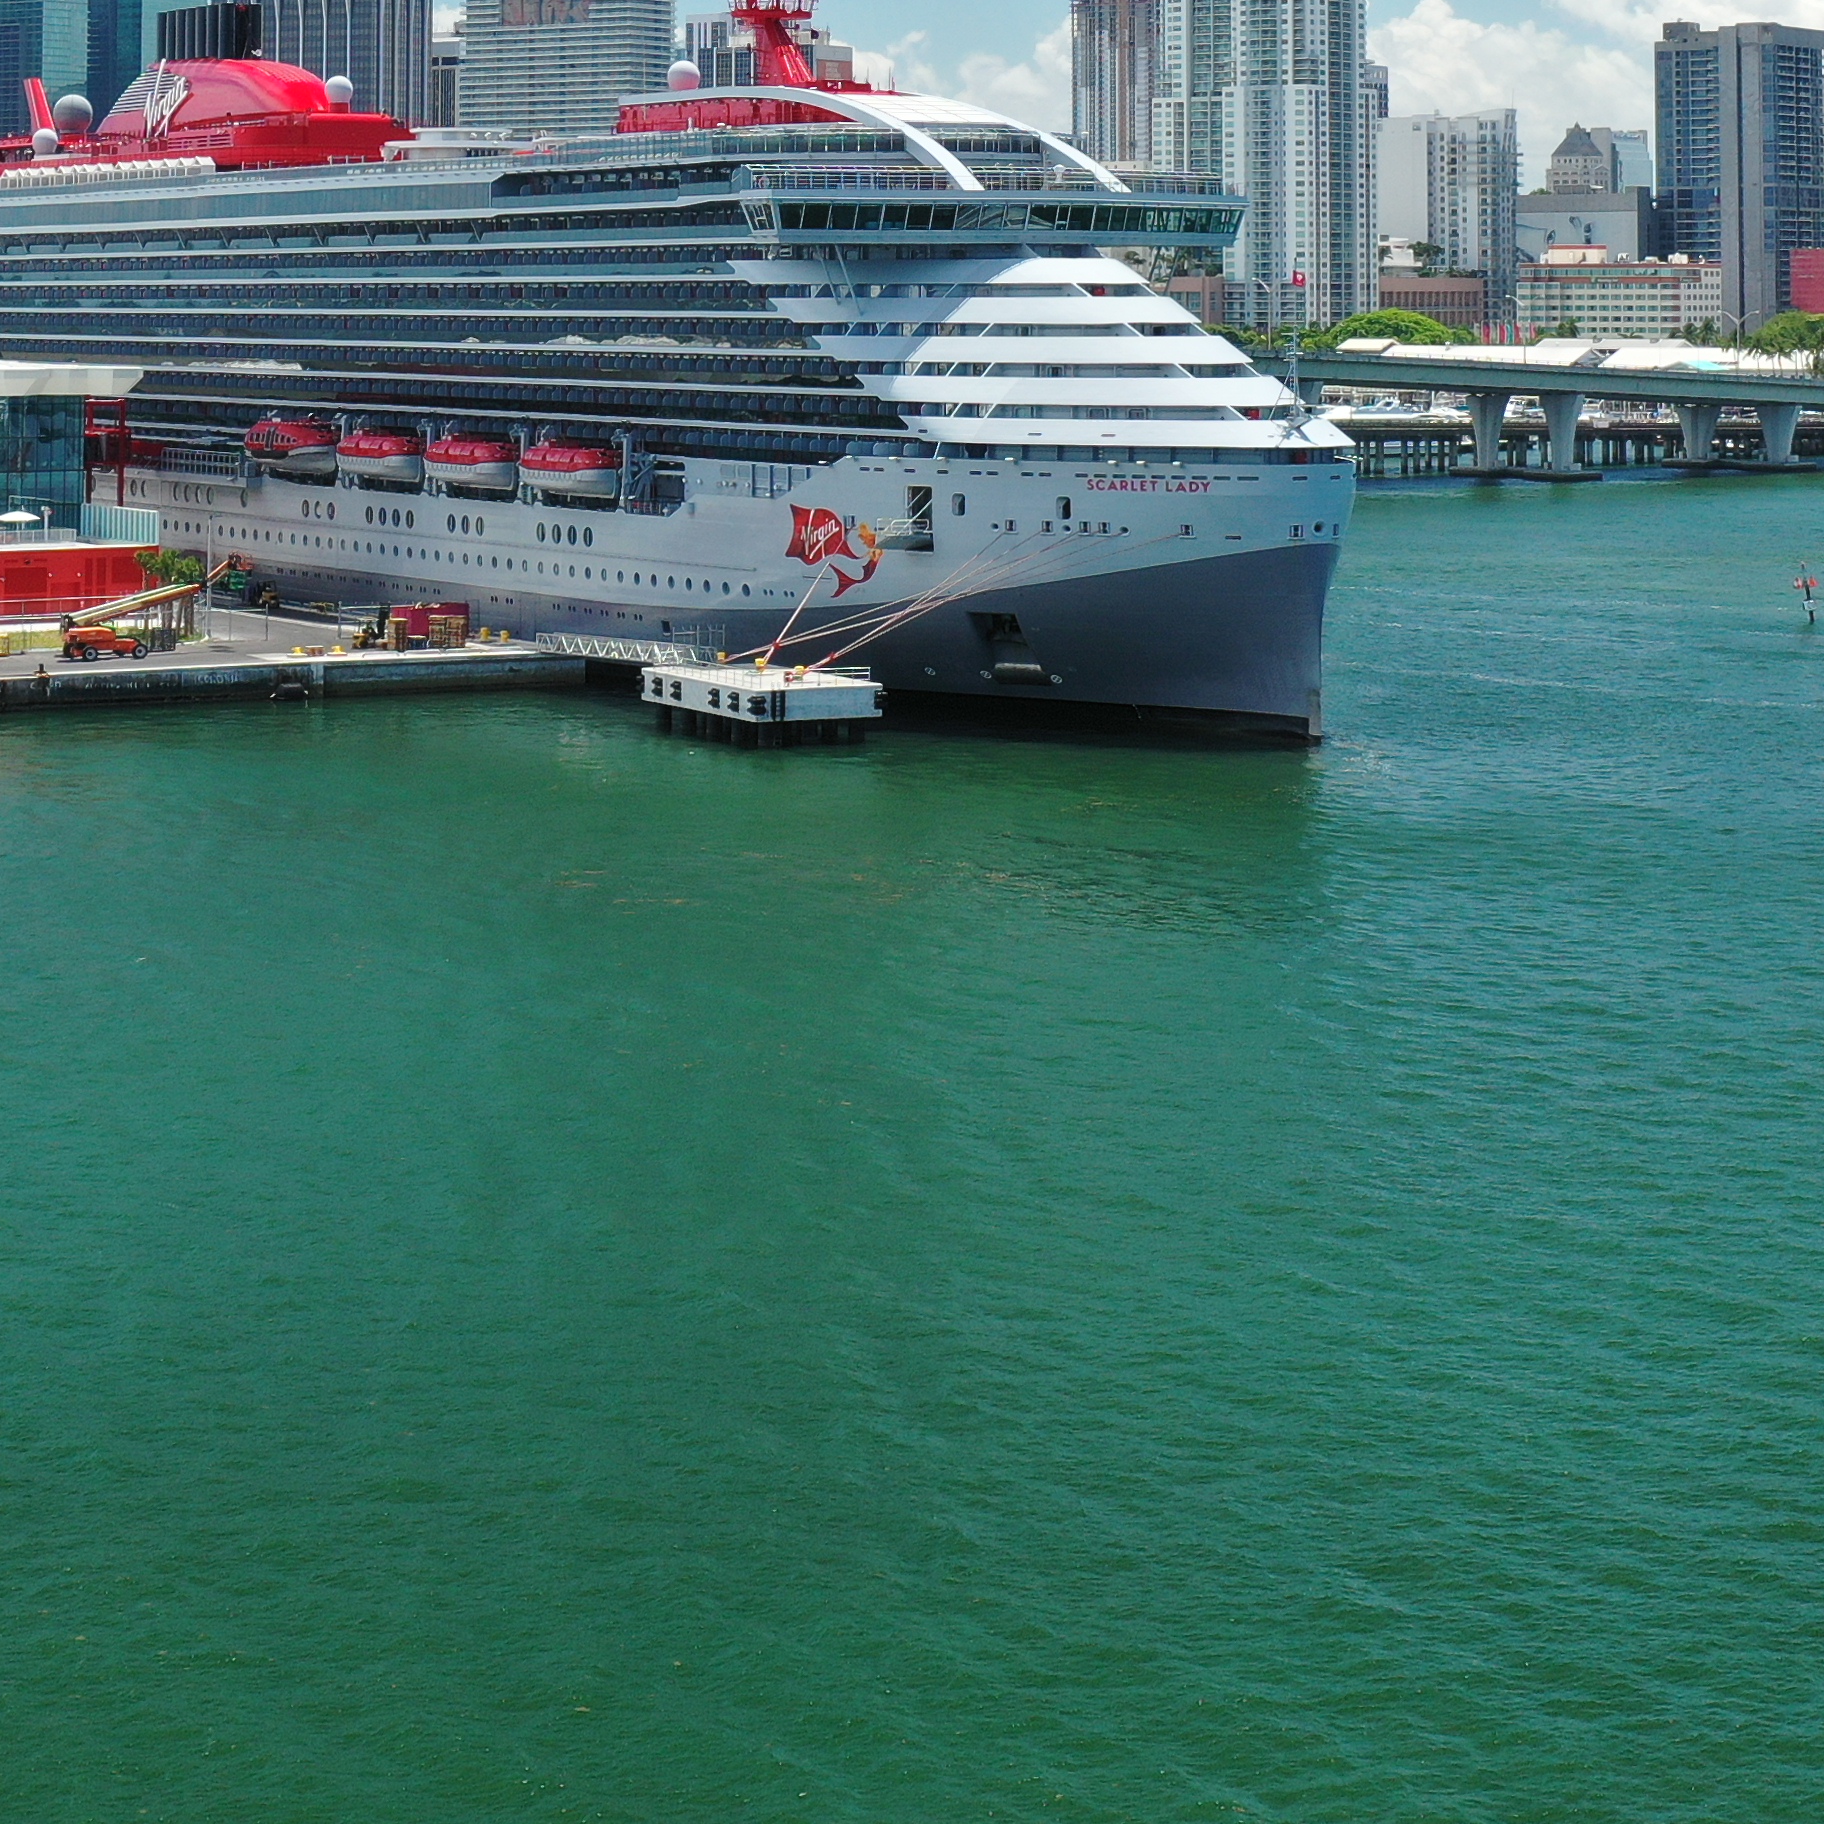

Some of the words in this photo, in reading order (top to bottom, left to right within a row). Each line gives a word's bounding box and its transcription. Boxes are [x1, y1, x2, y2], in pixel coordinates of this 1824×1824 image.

[143, 58, 188, 138] Virgin
[1087, 479, 1158, 491] SCARLET
[1165, 481, 1211, 493] LADY
[800, 509, 840, 559] Virgin
